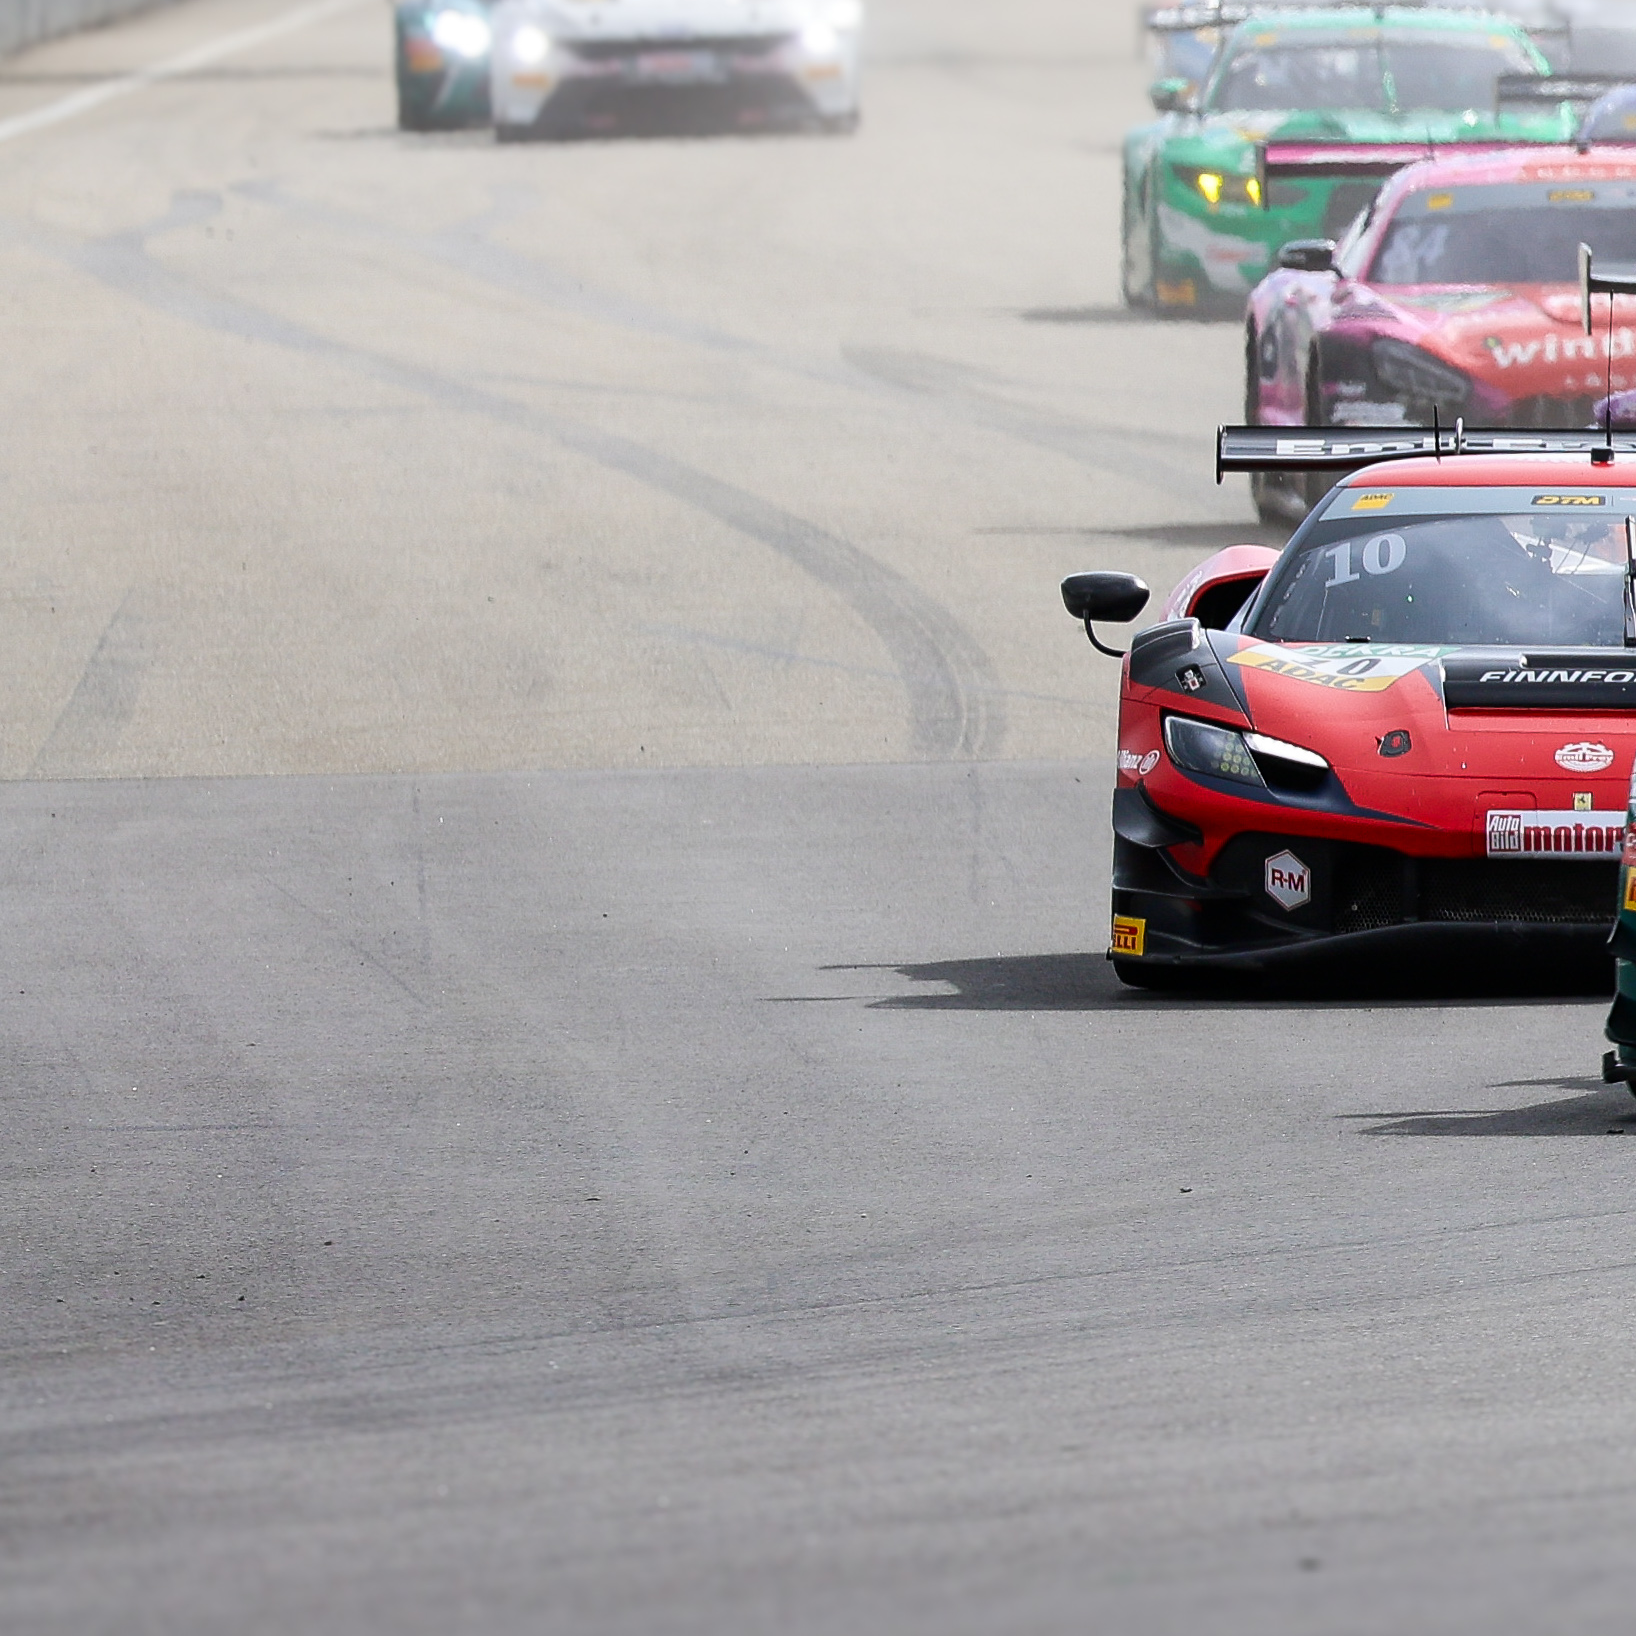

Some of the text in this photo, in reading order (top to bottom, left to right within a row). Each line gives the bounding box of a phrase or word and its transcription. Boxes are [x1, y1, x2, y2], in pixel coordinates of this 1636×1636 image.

[1535, 495, 1603, 506] DTM
[1325, 532, 1407, 588] 10
[1252, 660, 1367, 689] ADAC
[1489, 815, 1520, 831] Auto
[1491, 831, 1519, 850] Bild
[1271, 868, 1306, 894] R-M
